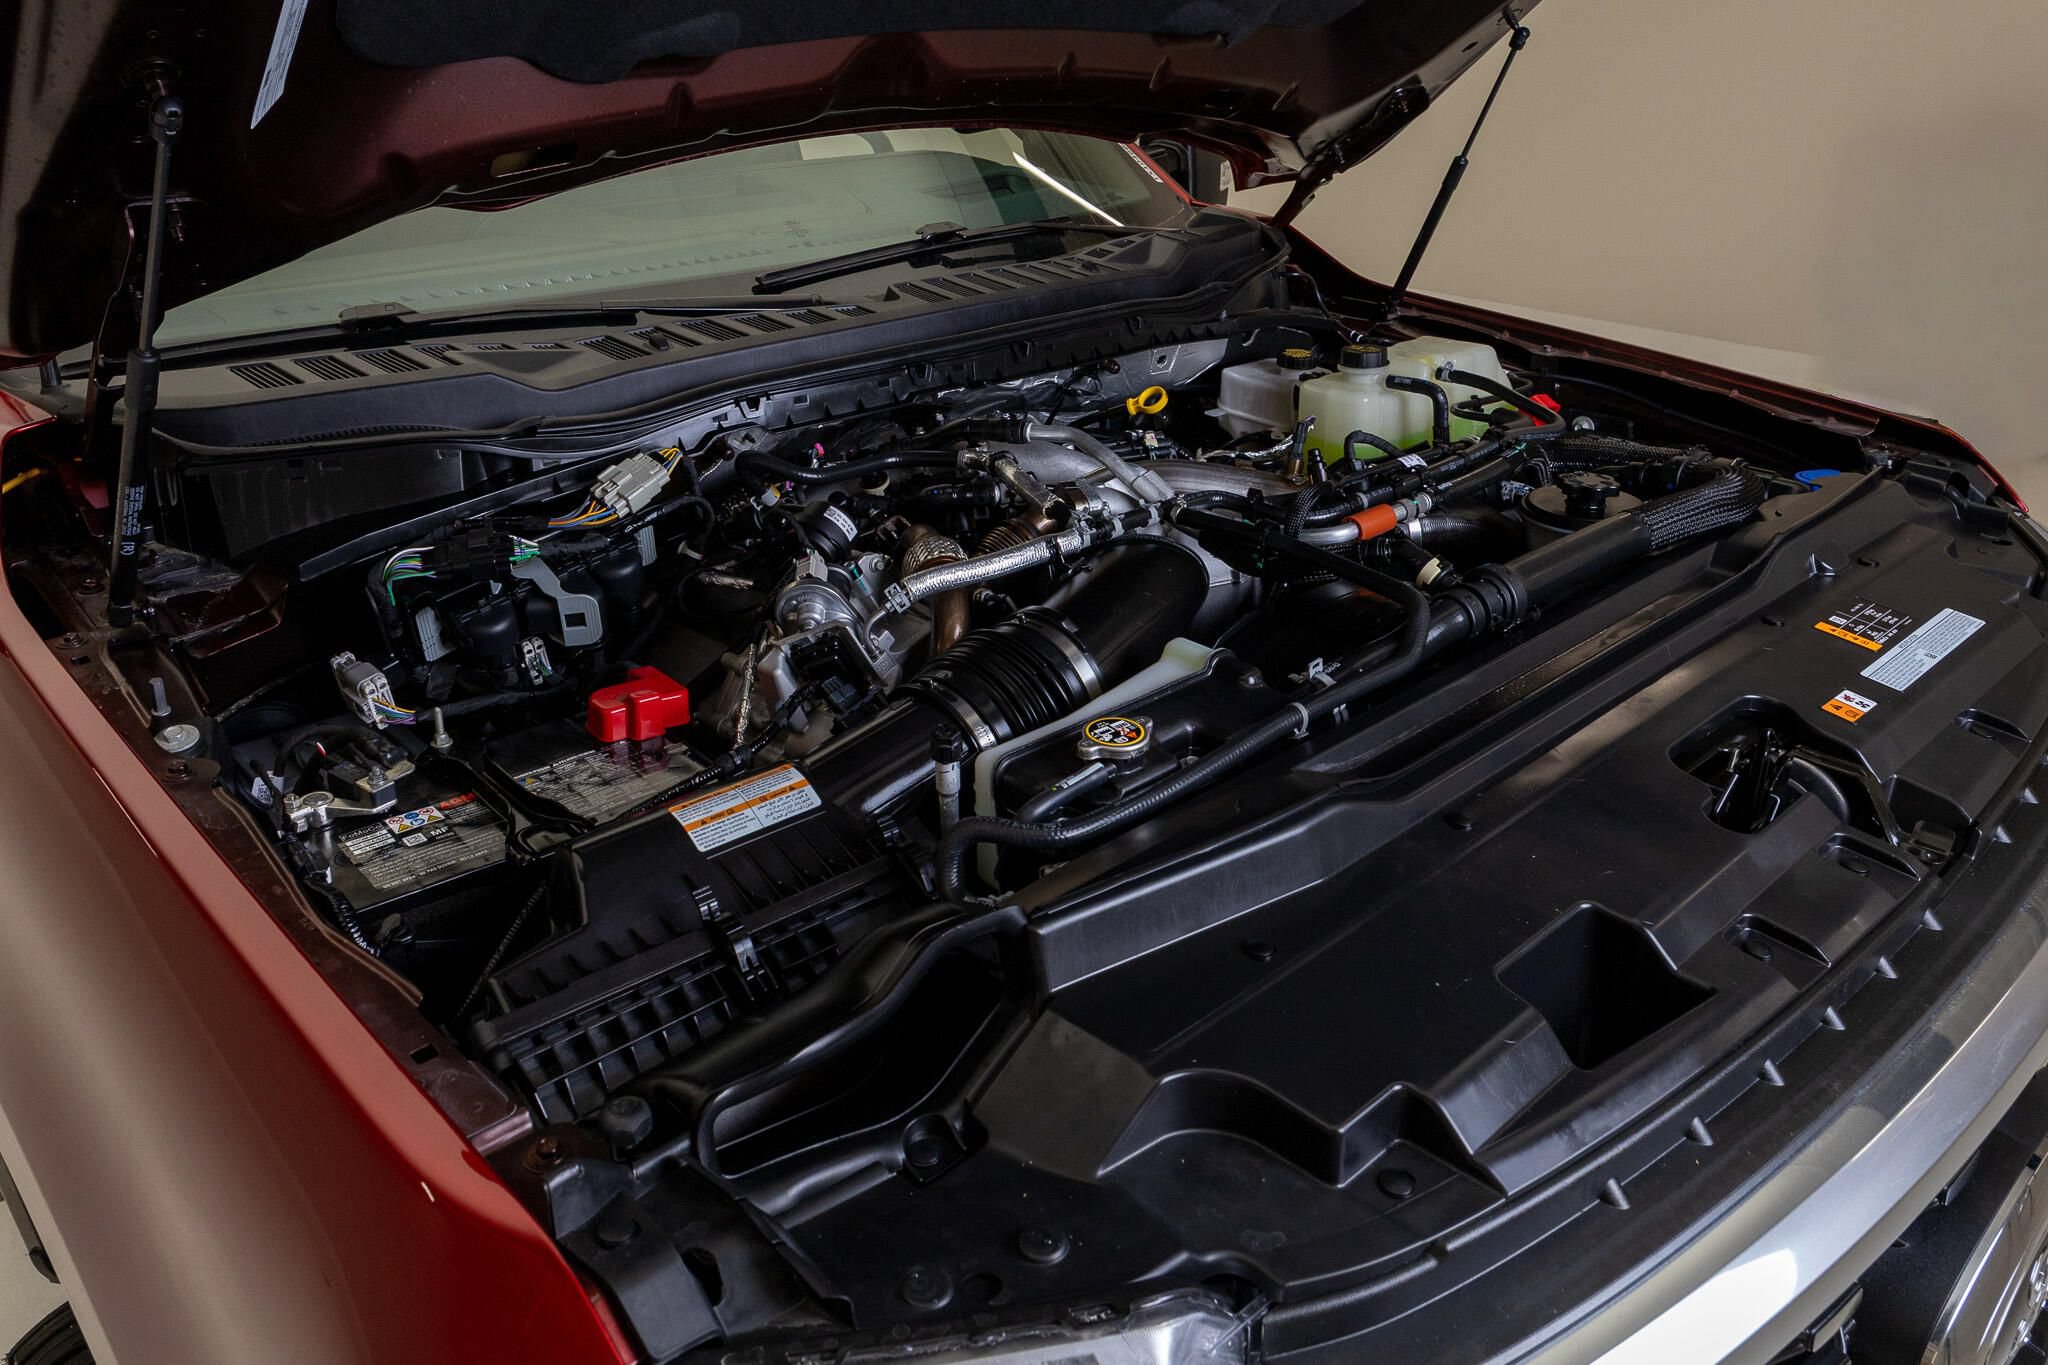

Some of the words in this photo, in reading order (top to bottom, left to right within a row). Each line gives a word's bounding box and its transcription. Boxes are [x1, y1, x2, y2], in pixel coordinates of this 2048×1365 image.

[439, 792, 478, 811] AGM
[342, 823, 384, 842] FoMoCo
[431, 826, 450, 837] MF
